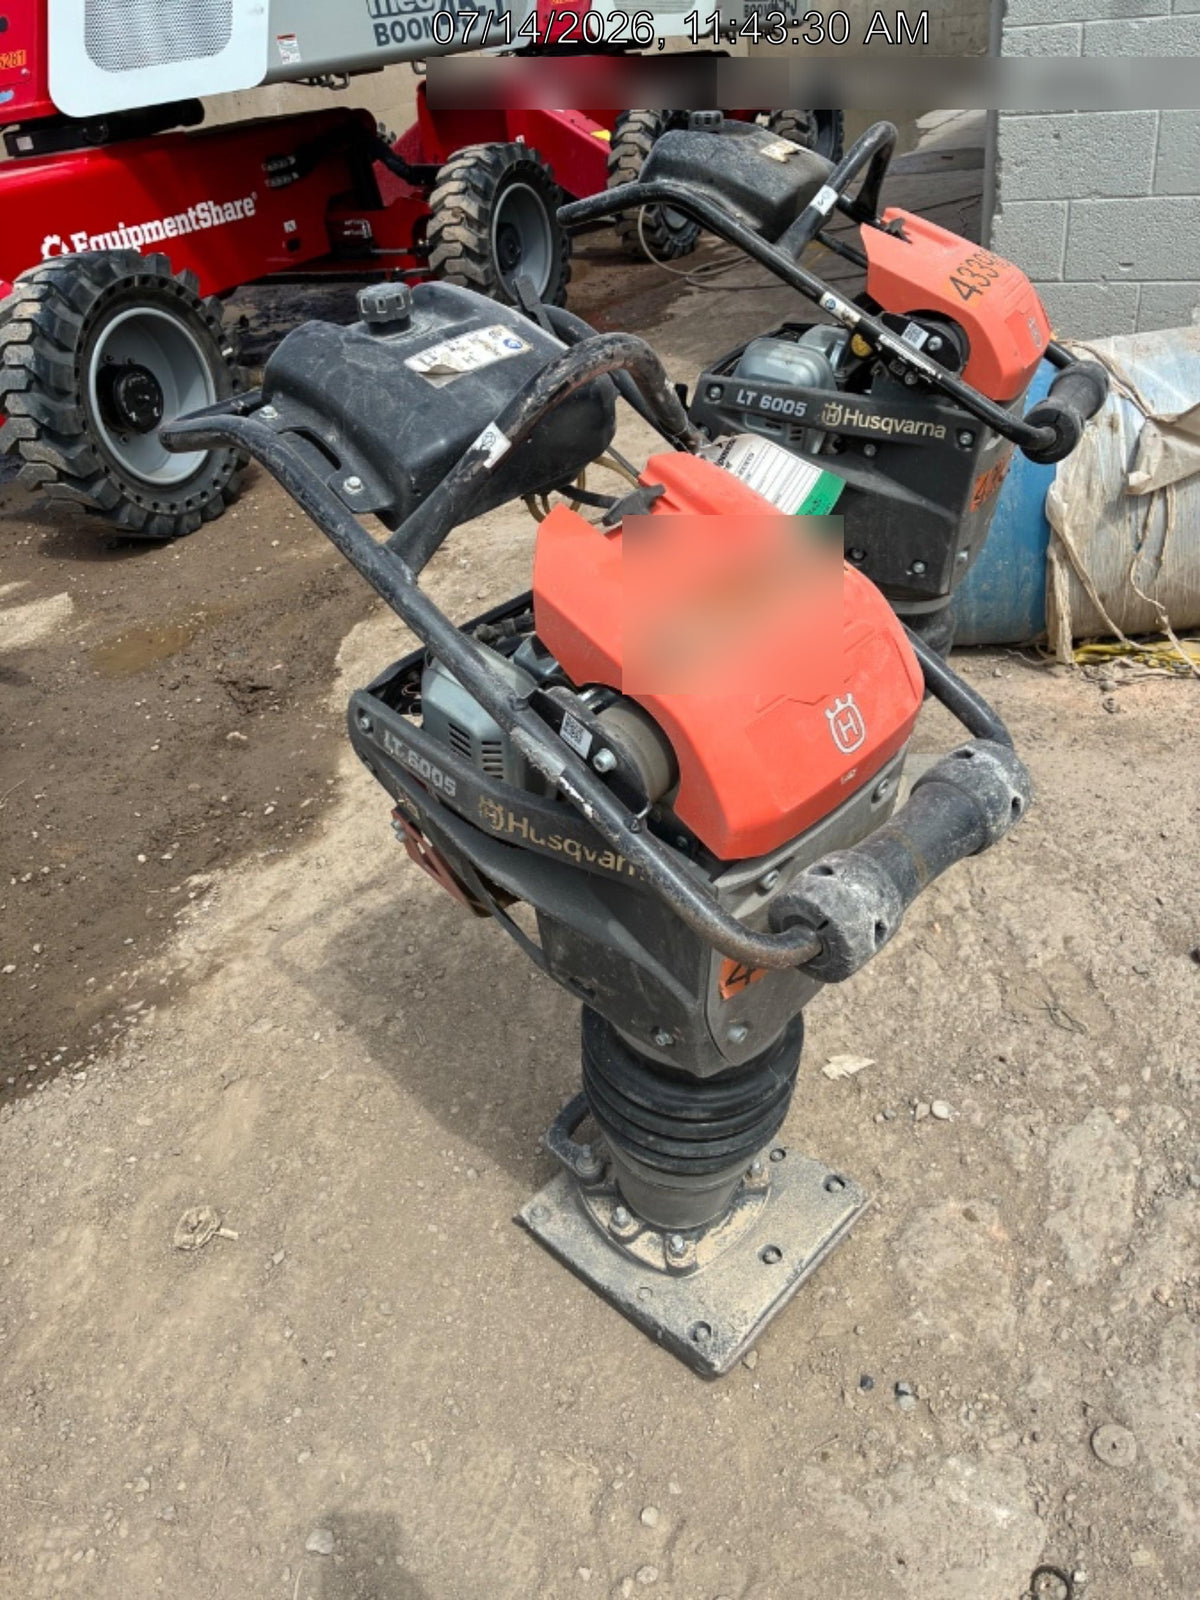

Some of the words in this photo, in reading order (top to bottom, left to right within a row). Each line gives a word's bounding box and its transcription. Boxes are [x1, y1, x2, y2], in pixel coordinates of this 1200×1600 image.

[736, 388, 757, 404] LT
[759, 395, 807, 417] 6005
[842, 407, 947, 441] Husqvarna
[408, 749, 456, 797] 6005
[508, 811, 646, 881] Husqvar
